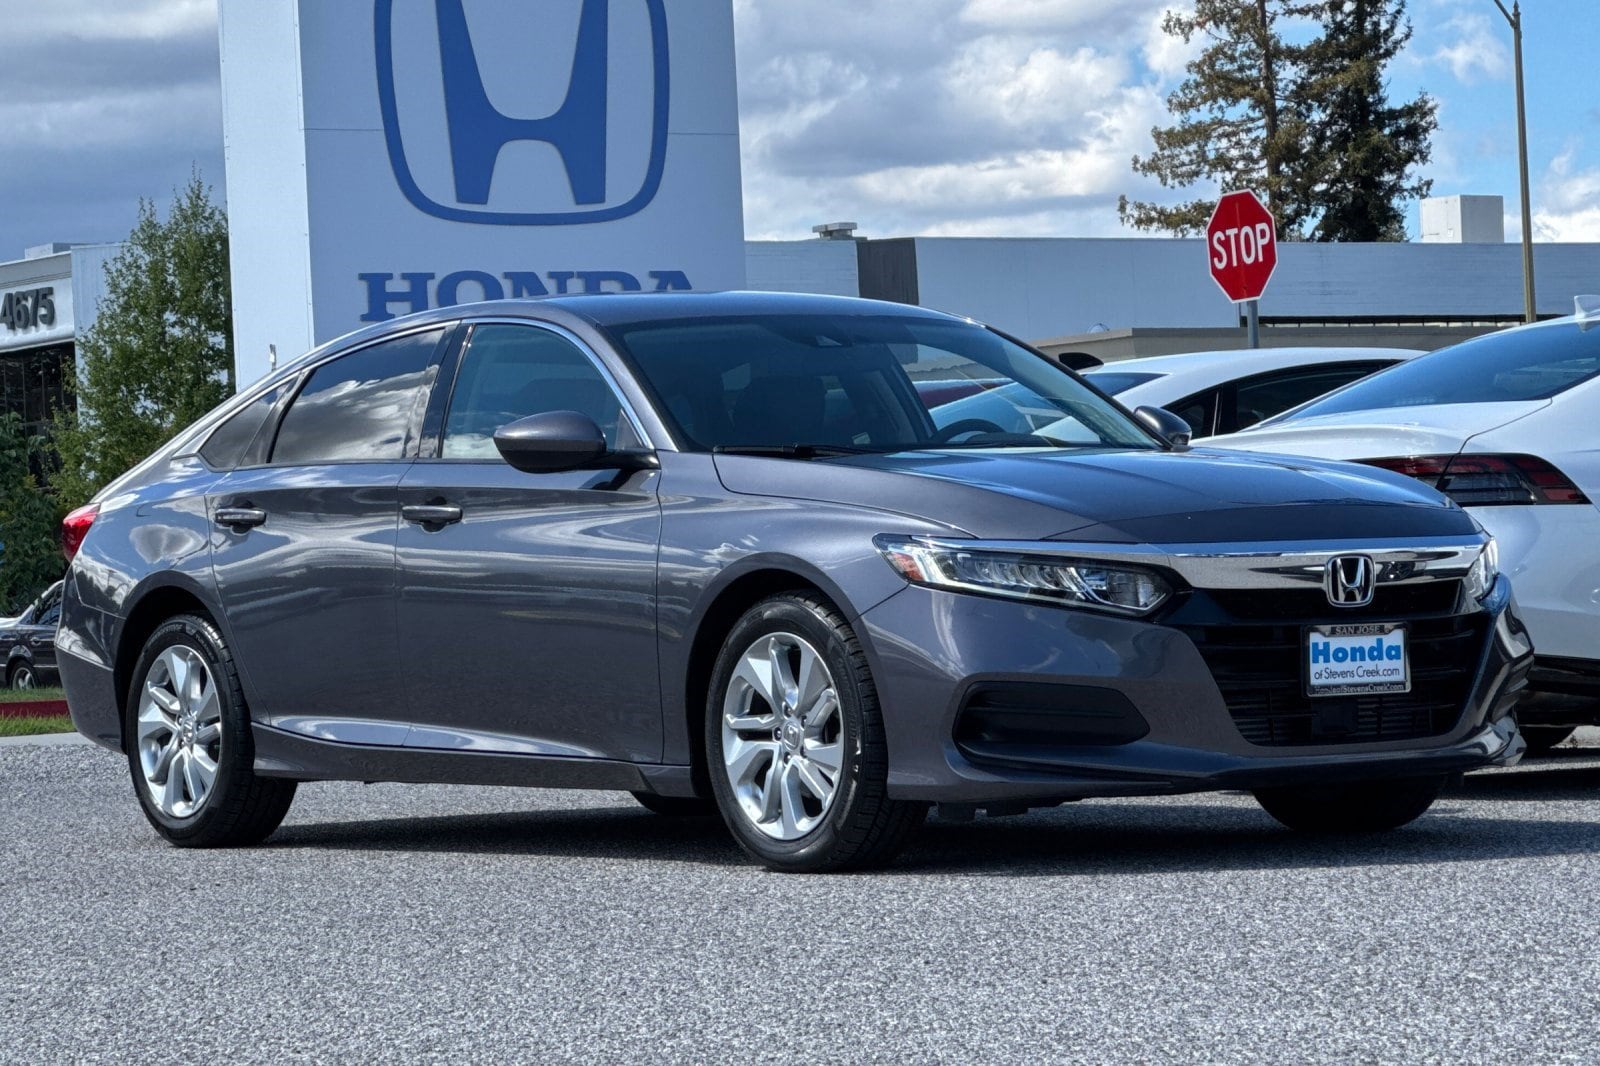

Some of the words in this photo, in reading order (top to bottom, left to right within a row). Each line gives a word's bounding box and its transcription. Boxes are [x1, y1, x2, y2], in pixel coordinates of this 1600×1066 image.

[1212, 222, 1270, 270] STOP
[0, 286, 55, 331] 4675
[1335, 626, 1355, 635] SAN
[1356, 625, 1381, 635] JOSE
[1311, 637, 1402, 664] Honda
[1314, 669, 1323, 680] of
[1323, 667, 1355, 680] Stevens
[1355, 664, 1400, 678] Creek.com
